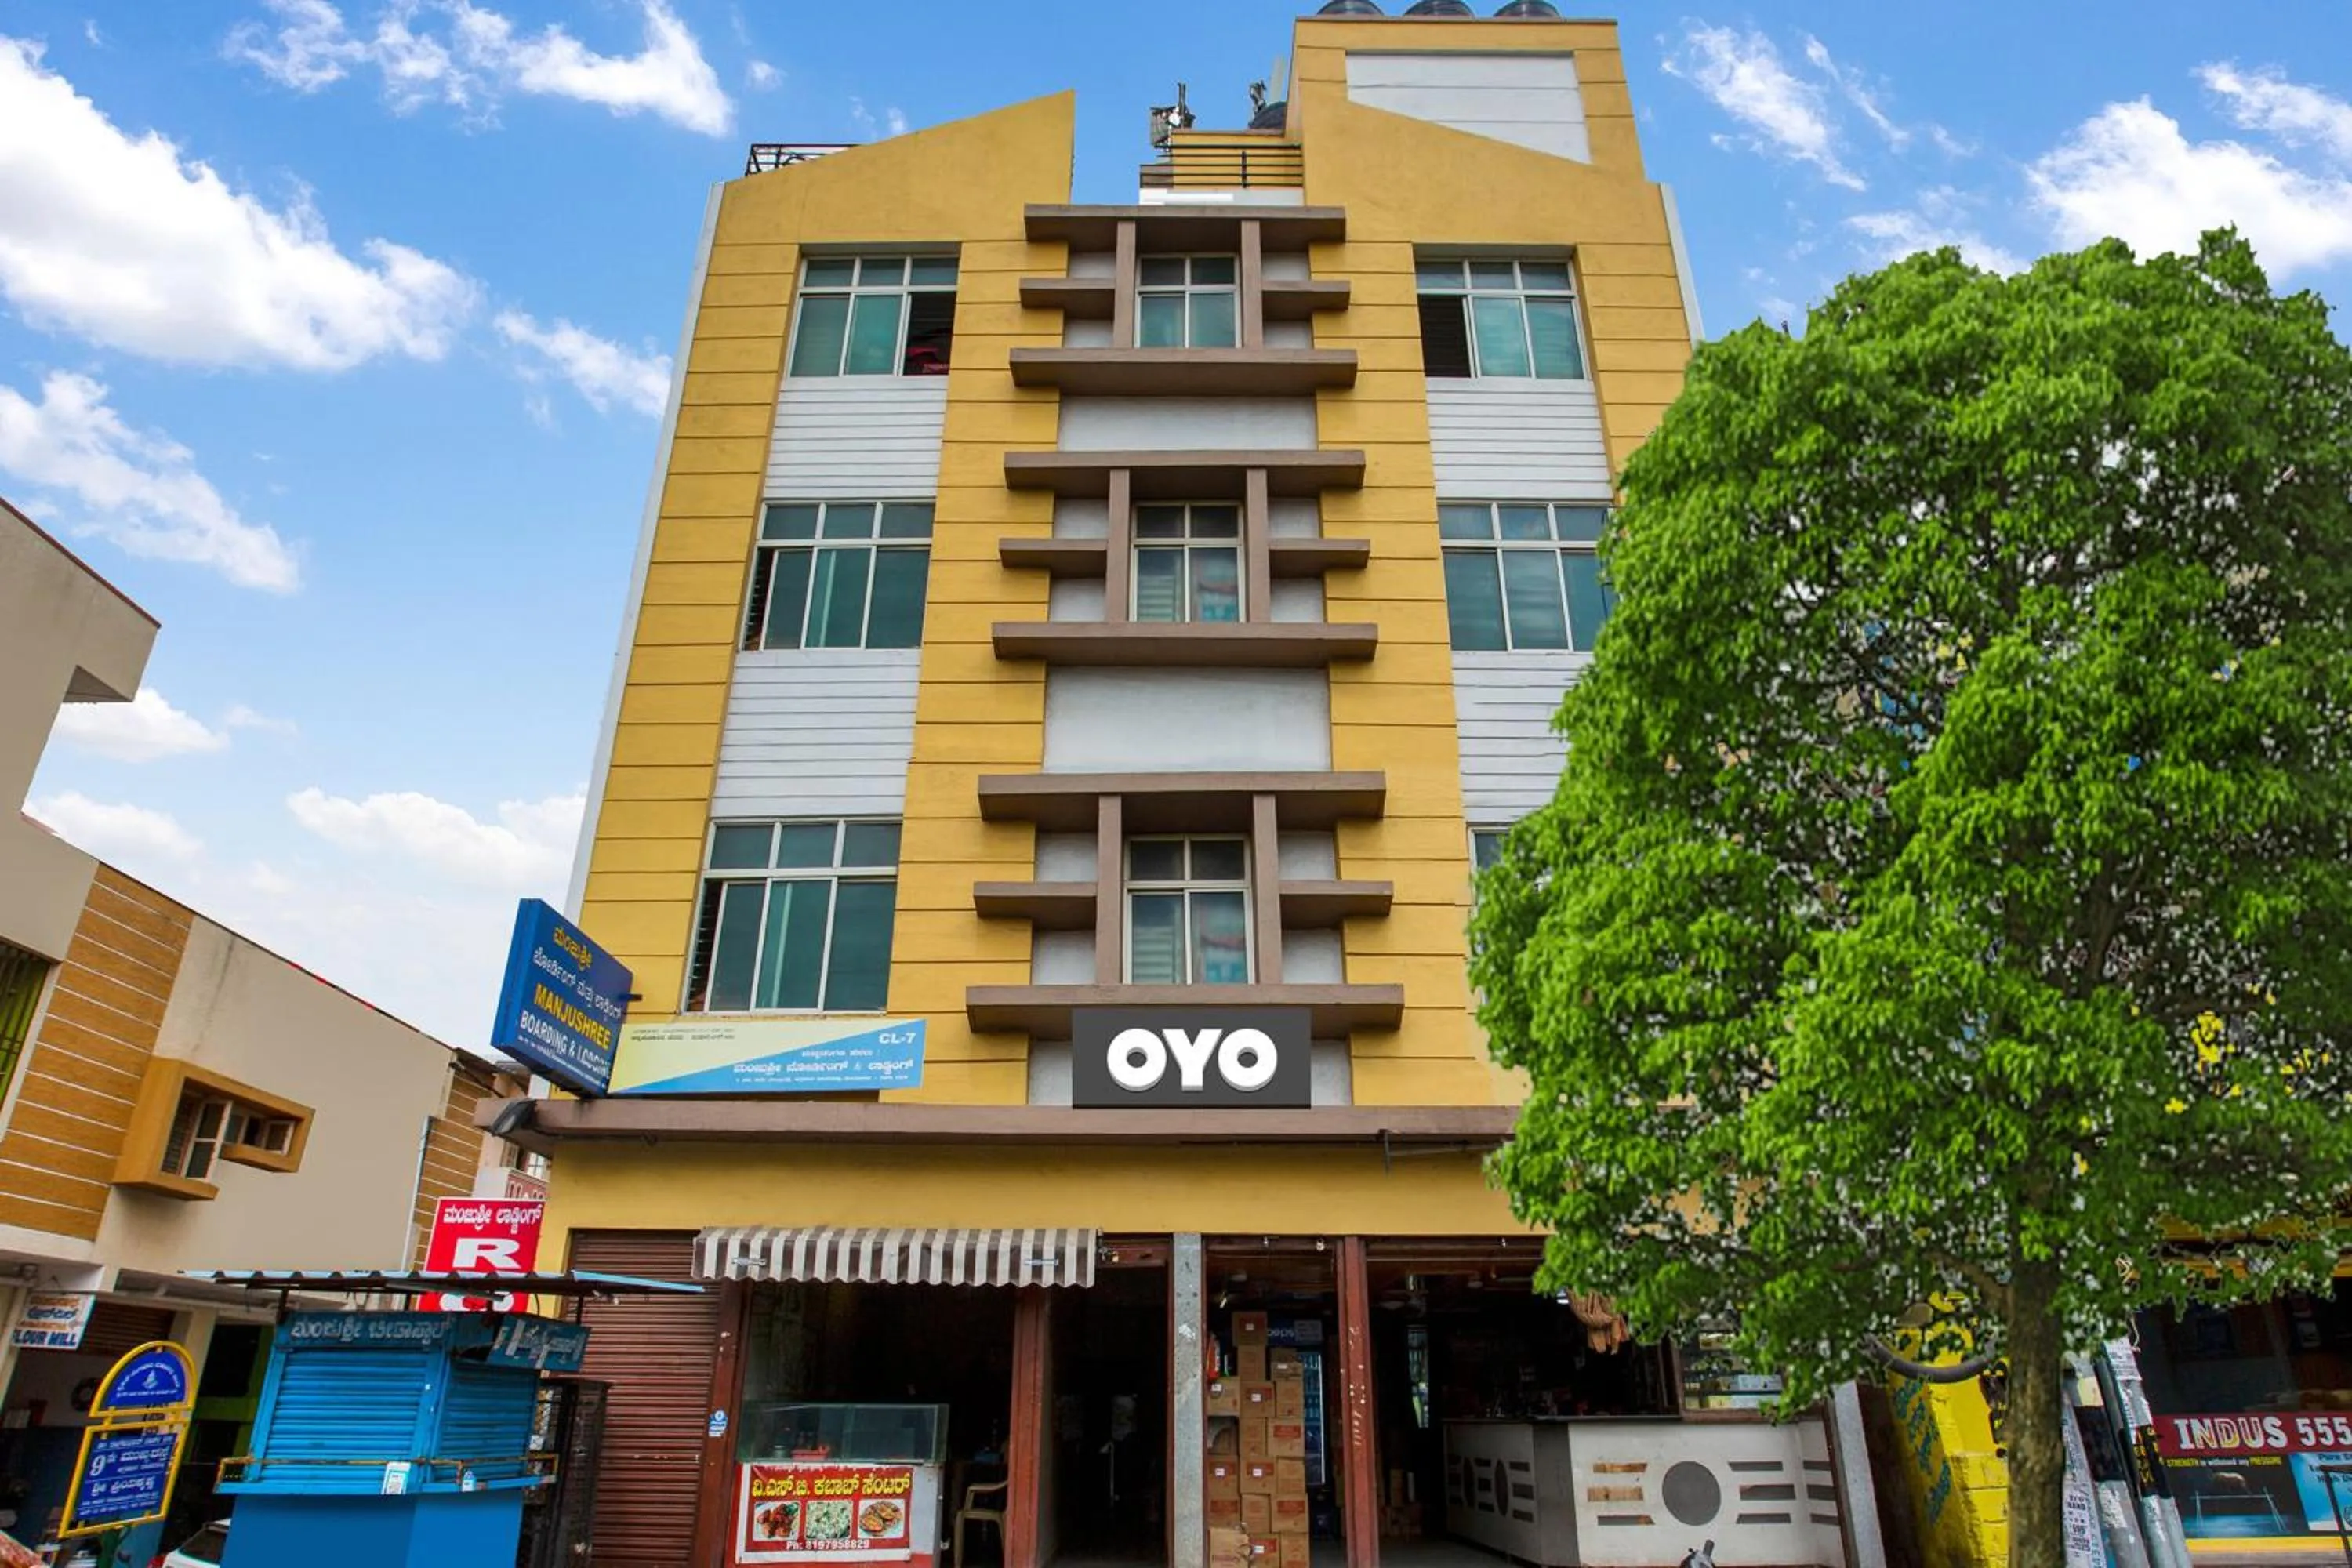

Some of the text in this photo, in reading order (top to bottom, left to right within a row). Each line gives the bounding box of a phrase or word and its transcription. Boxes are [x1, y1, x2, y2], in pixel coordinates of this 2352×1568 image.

[520, 1009, 568, 1054] BOARDING
[568, 1040, 576, 1058] &
[534, 982, 613, 1051] MANJUSHREE
[878, 1032, 916, 1044] CL-7
[1106, 1027, 1278, 1092] OYO
[452, 1238, 521, 1269] R
[2173, 1417, 2352, 1450] INDUS 555
